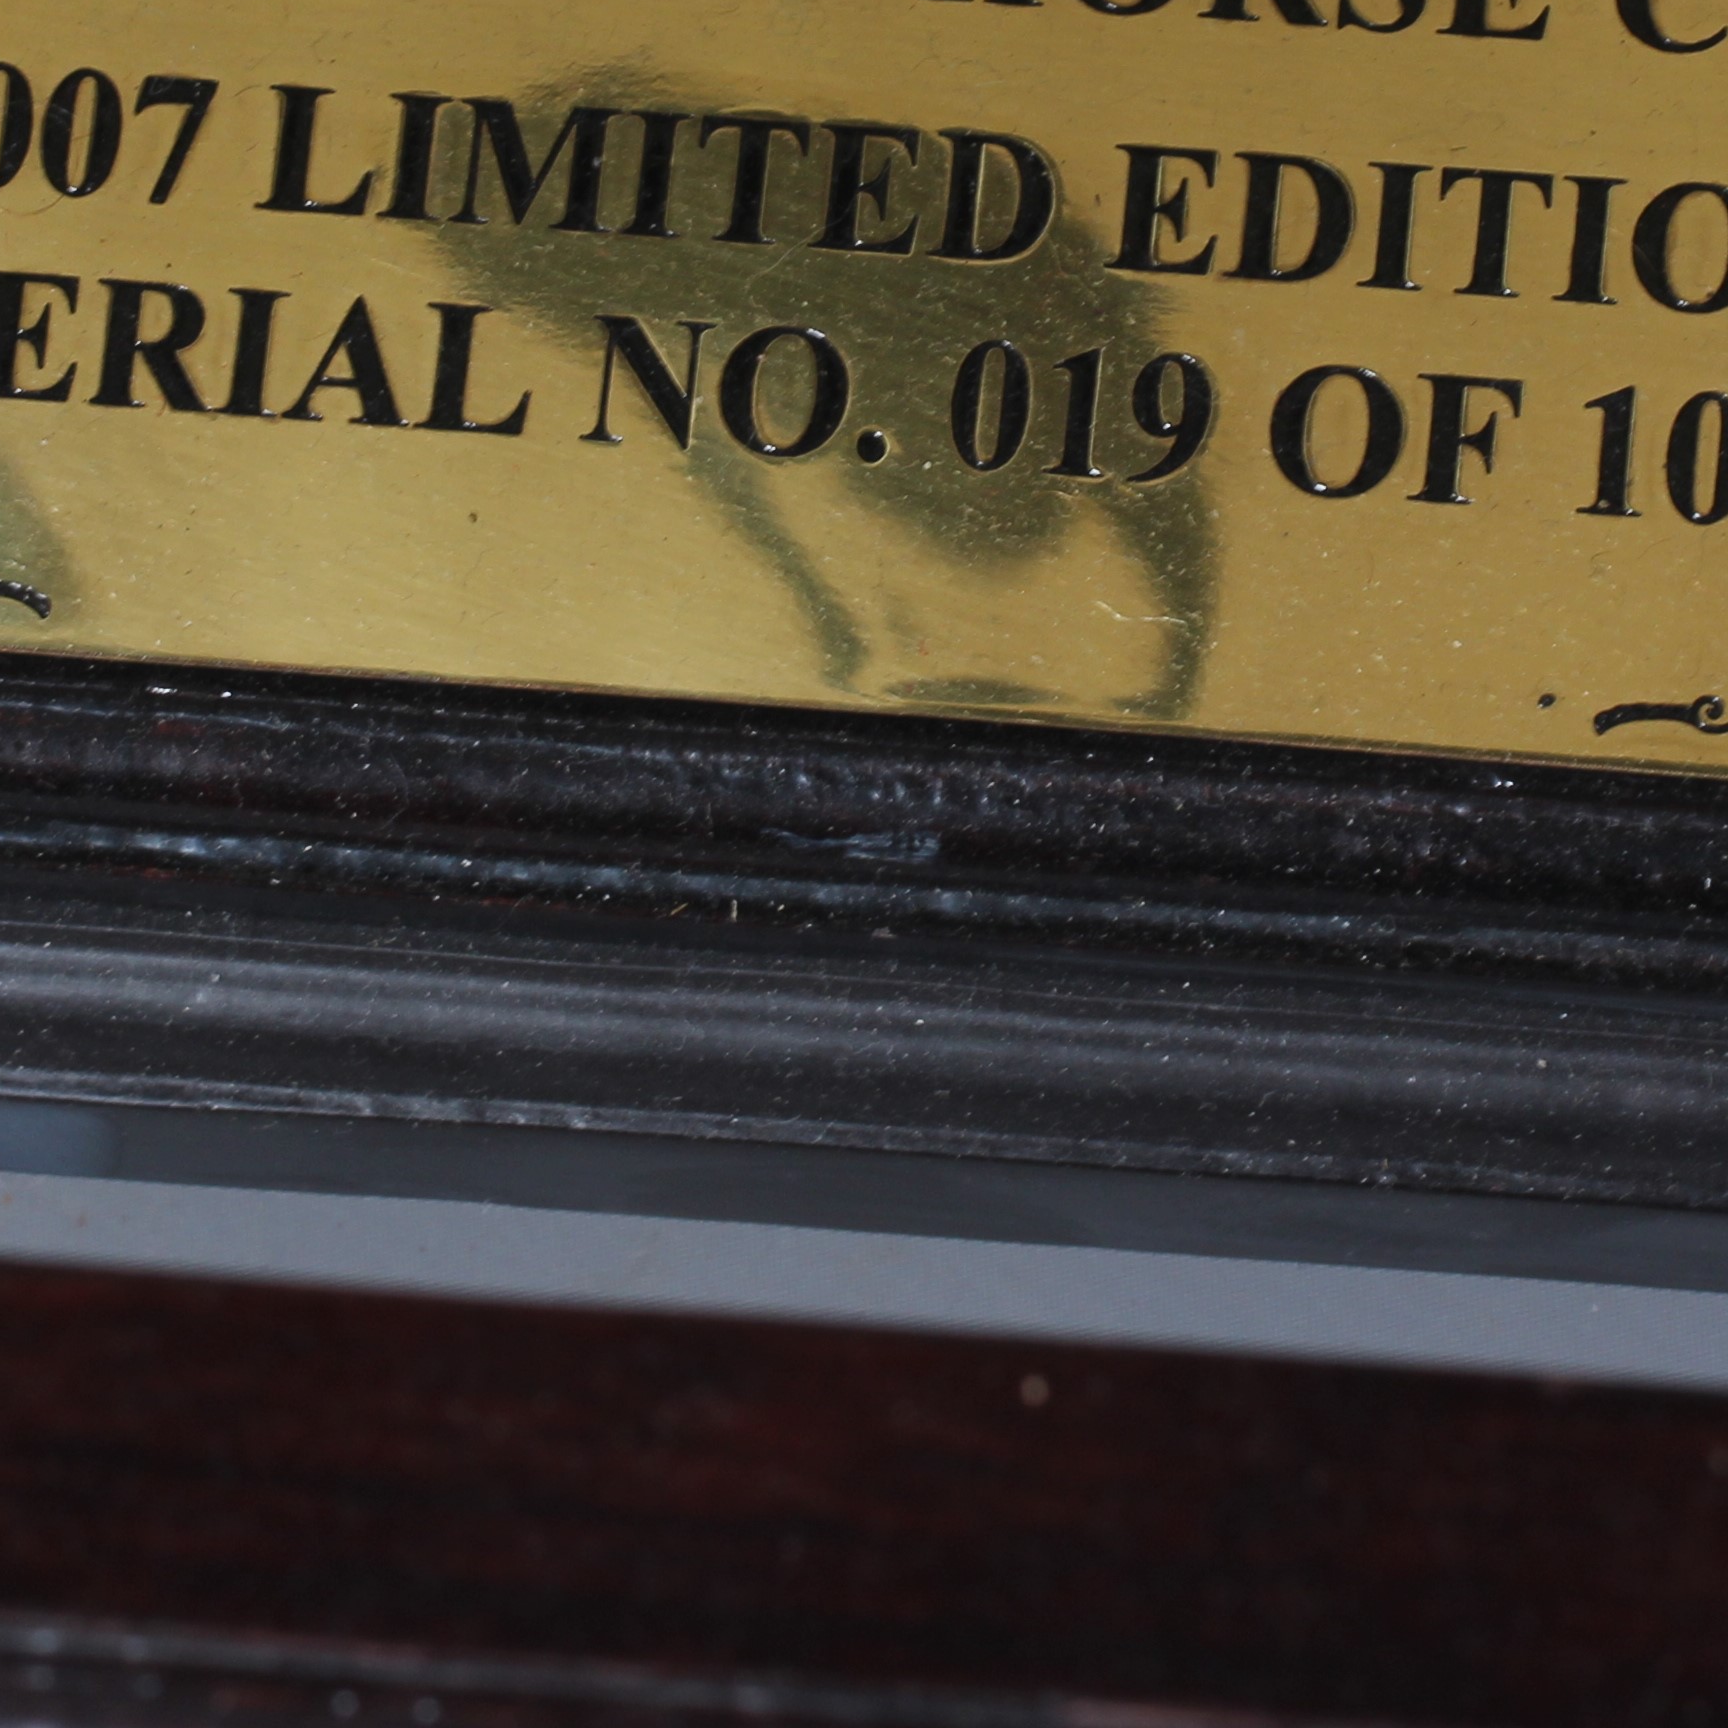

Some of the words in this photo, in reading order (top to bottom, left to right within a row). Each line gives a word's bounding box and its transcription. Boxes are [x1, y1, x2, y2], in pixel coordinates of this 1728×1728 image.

[255, 84, 1059, 266] LIMITED
[580, 315, 888, 466] NO.
[949, 339, 1214, 488] 019
[1273, 363, 1525, 509] OF
